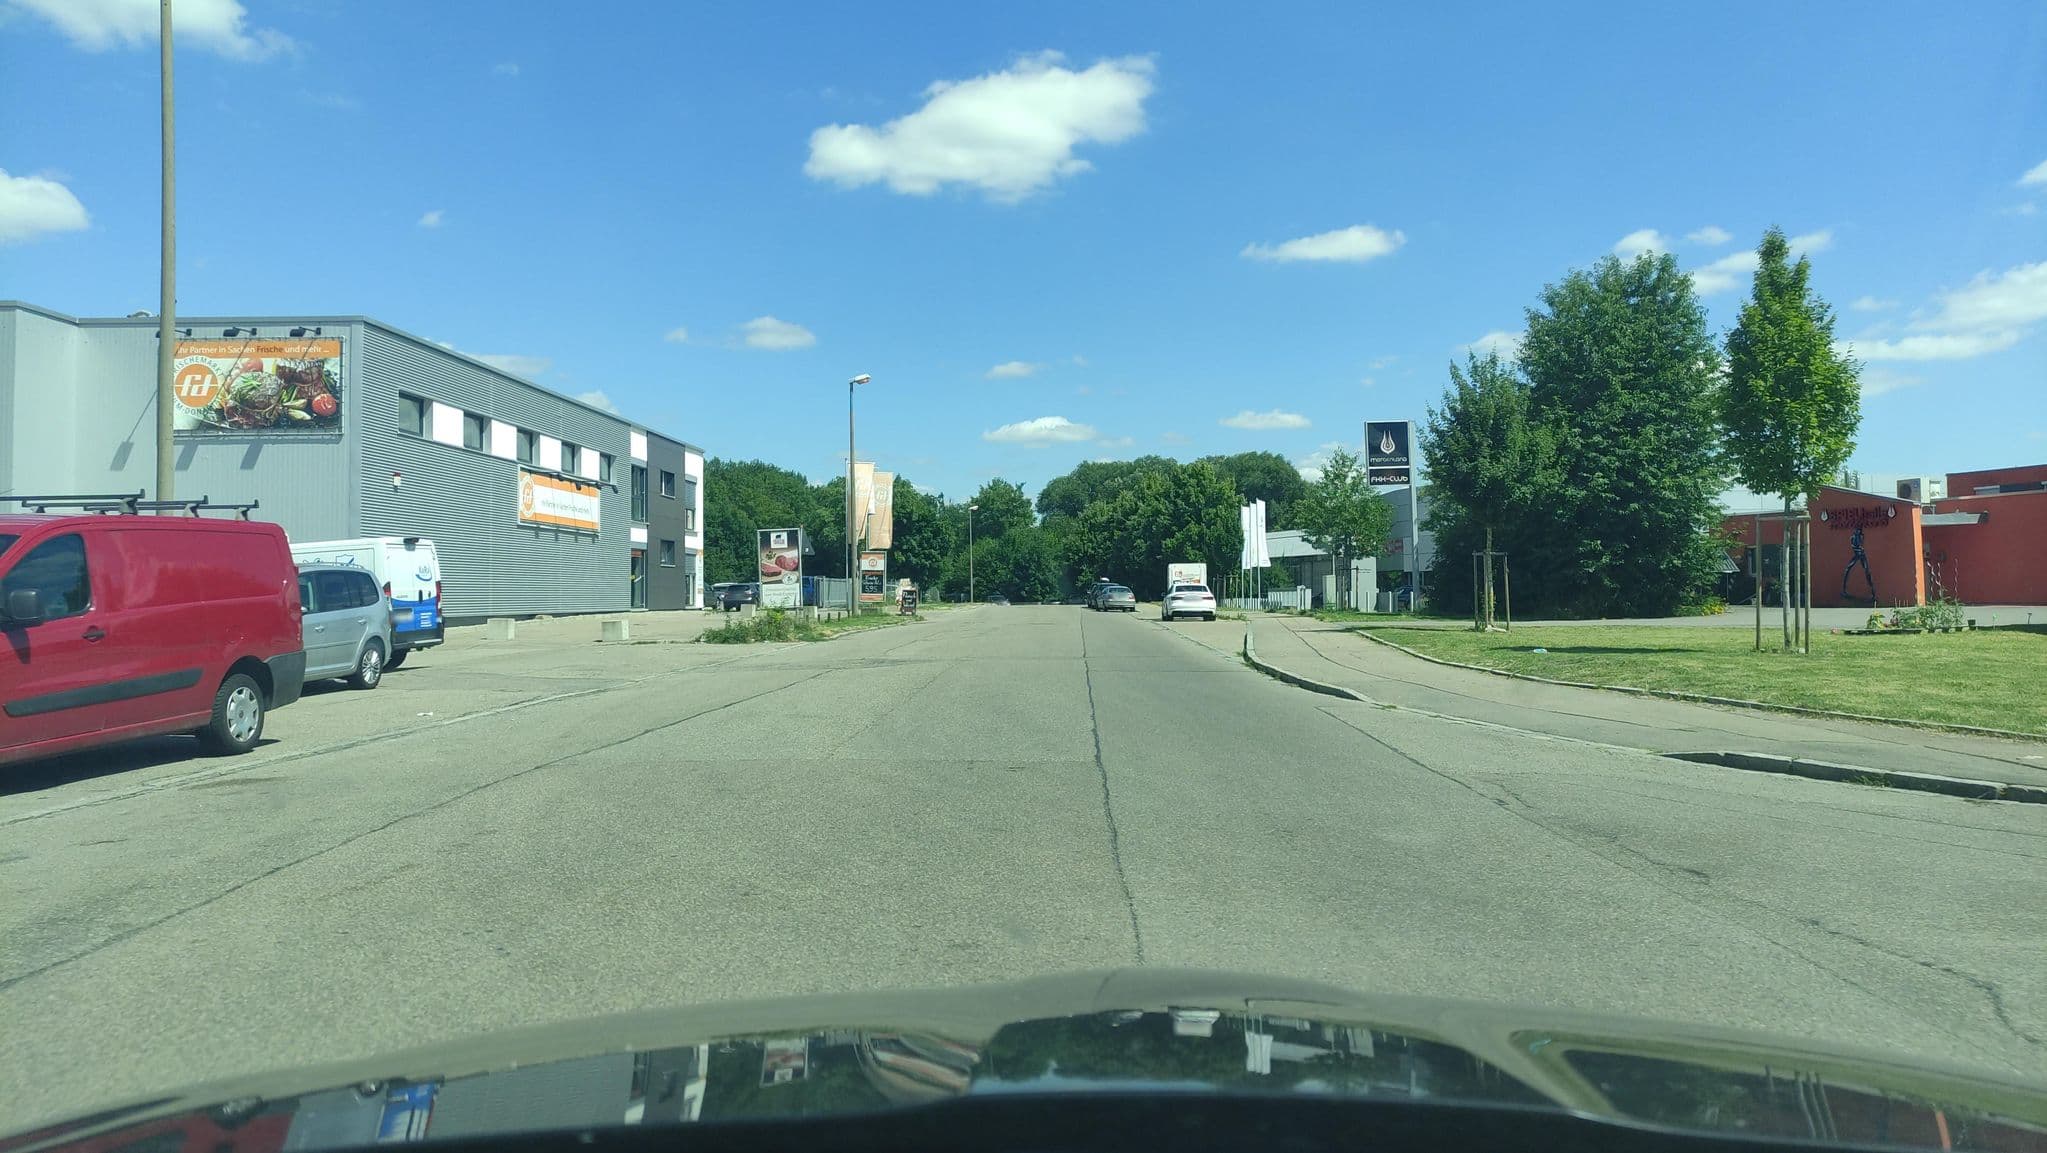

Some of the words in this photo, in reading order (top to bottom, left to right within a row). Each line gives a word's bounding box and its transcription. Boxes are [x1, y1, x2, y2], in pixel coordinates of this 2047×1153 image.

[190, 346, 217, 354] Partner
[227, 345, 255, 353] Sachen
[257, 345, 283, 353] Frische
[285, 345, 300, 353] und
[302, 345, 321, 353] mehr
